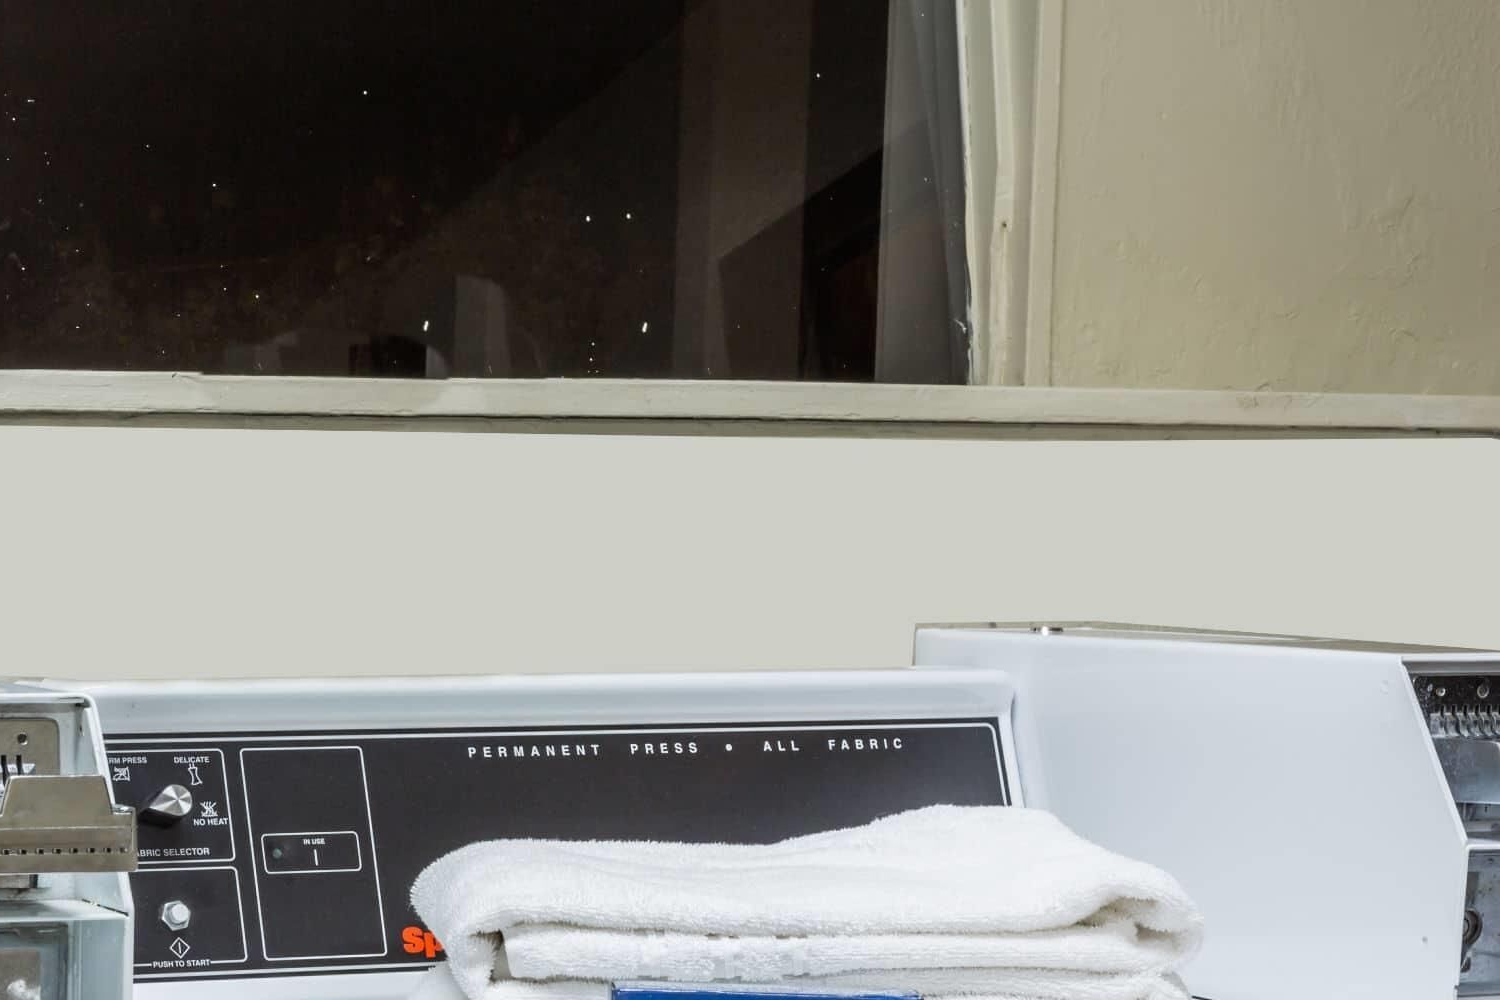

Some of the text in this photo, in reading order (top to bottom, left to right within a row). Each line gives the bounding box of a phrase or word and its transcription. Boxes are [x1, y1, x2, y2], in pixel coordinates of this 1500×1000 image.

[468, 738, 902, 758] PERMANENT PRESS ALL FABRIC
[122, 756, 147, 764] PRESS
[173, 756, 210, 764] DELICATE
[193, 818, 206, 826] NO
[163, 847, 210, 857] SELECTOR
[153, 959, 210, 968] PUSH TO START
